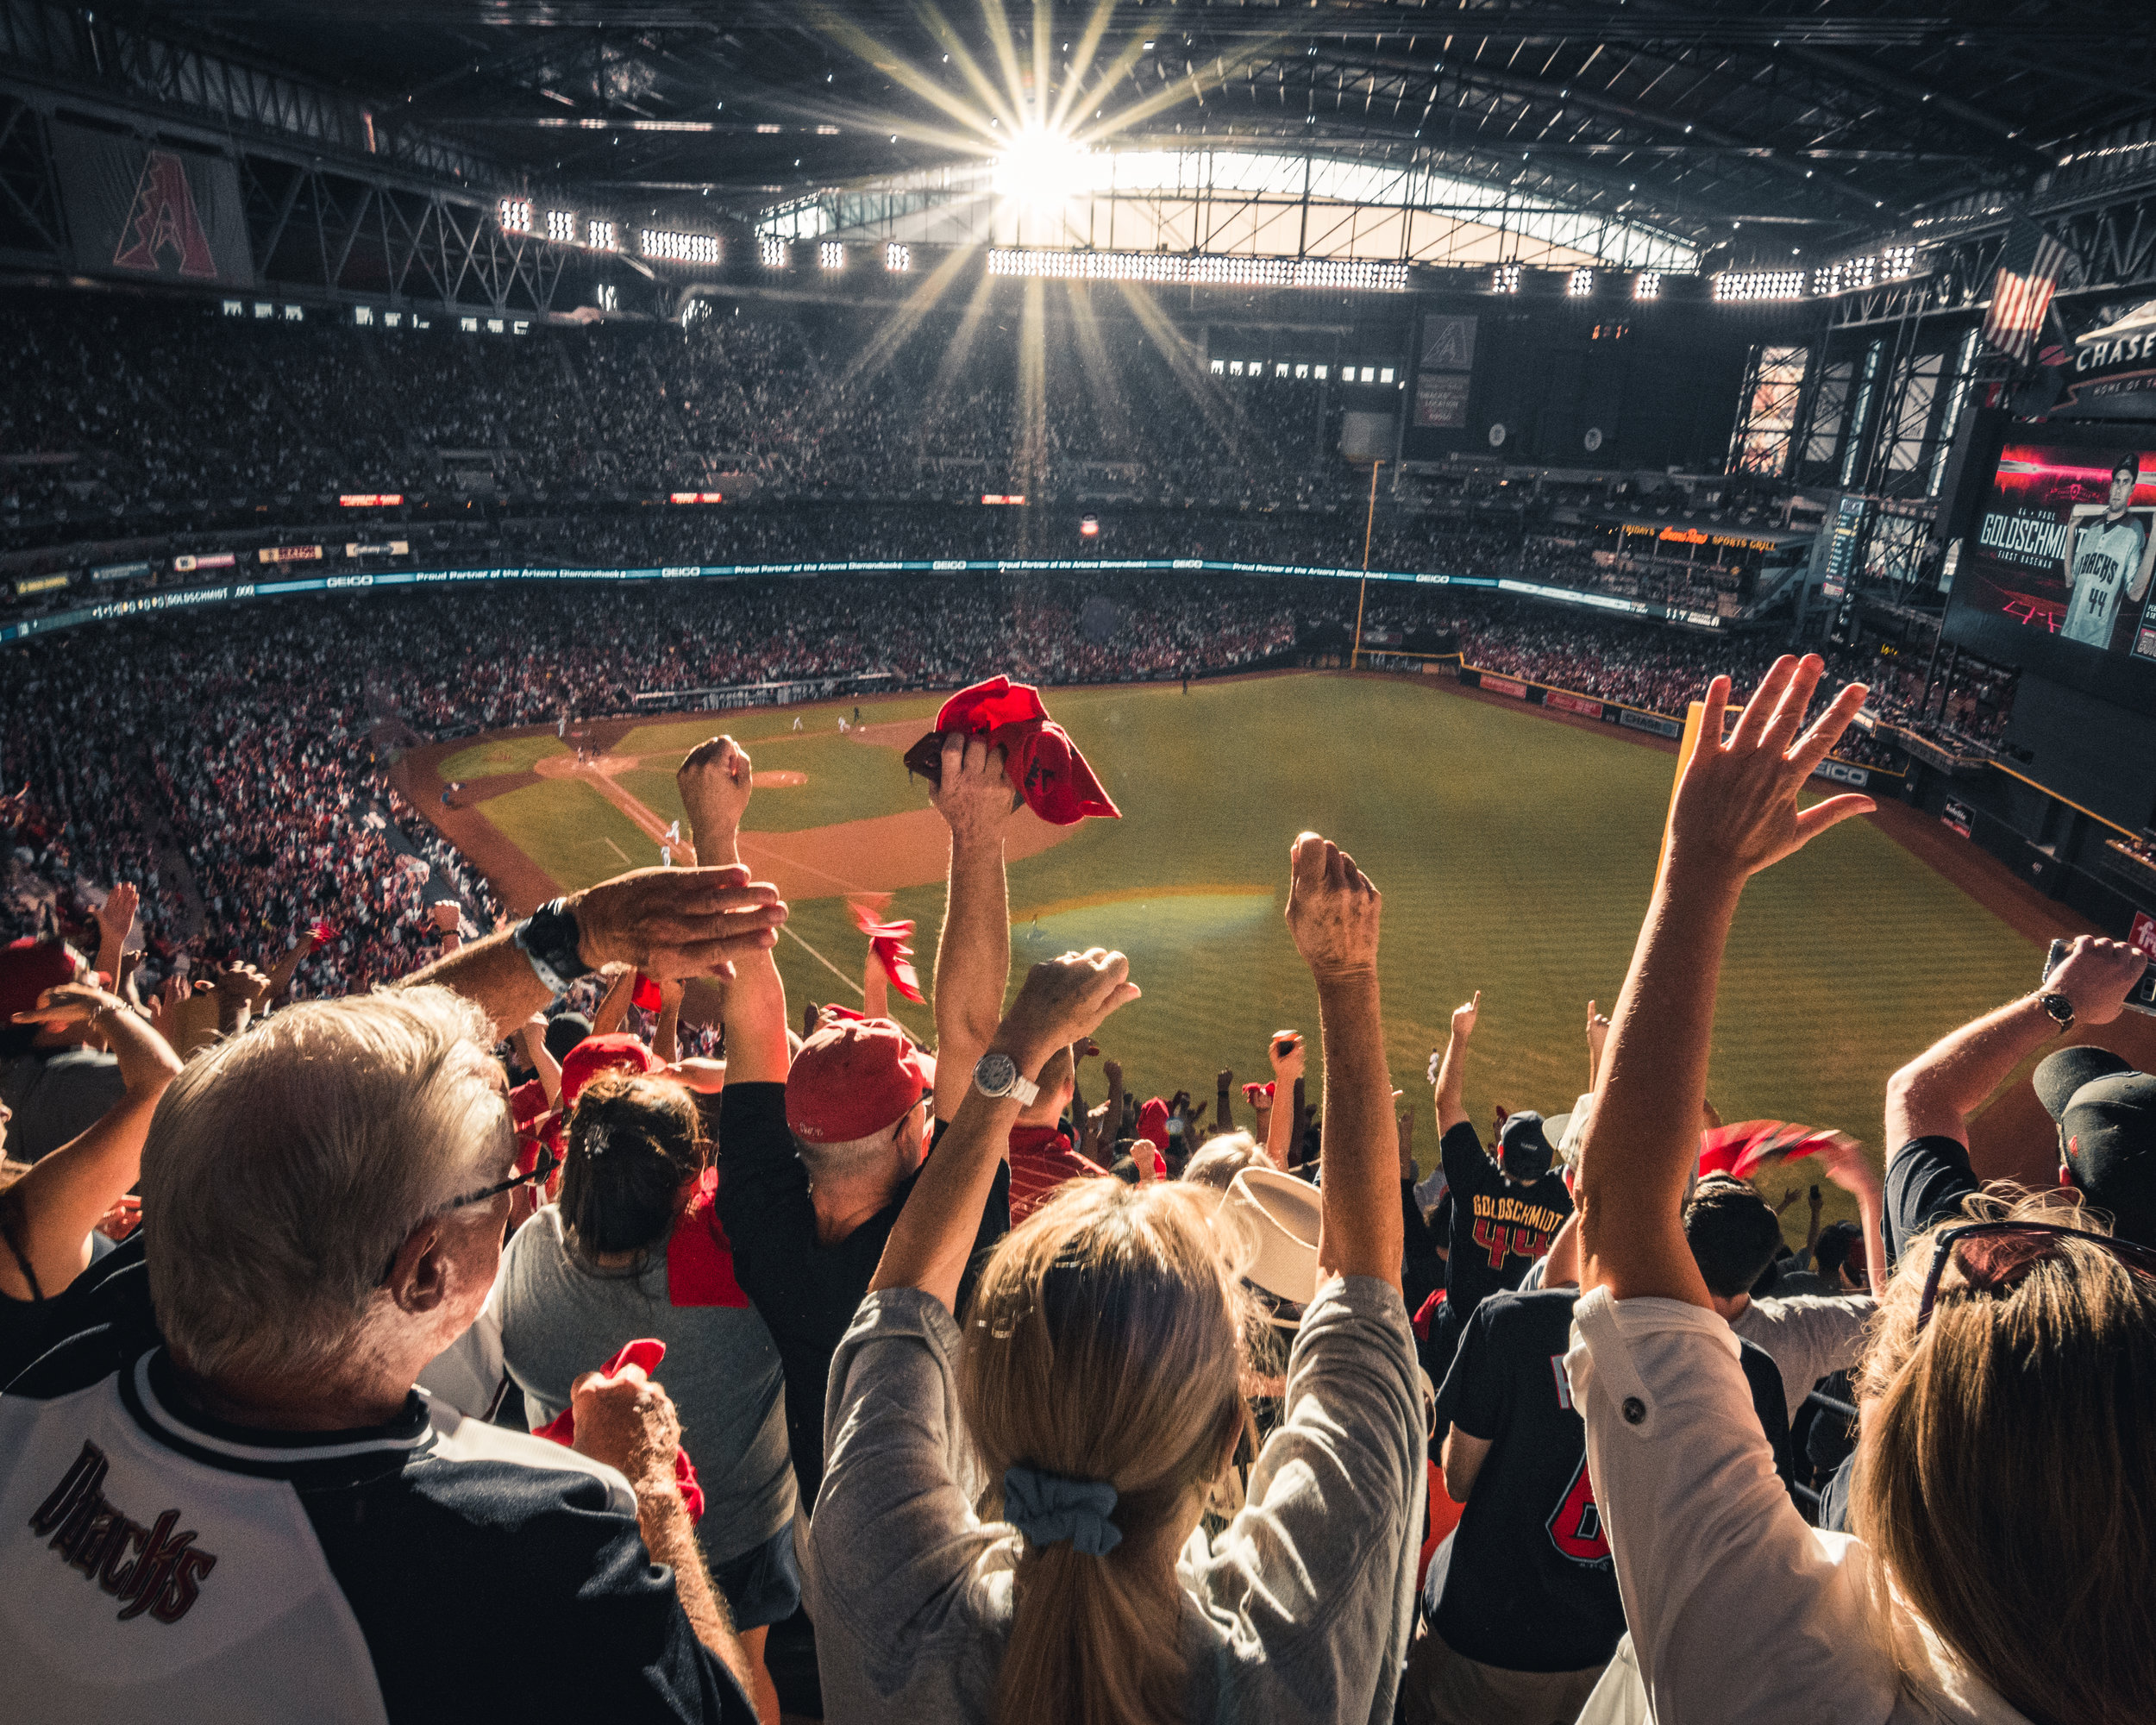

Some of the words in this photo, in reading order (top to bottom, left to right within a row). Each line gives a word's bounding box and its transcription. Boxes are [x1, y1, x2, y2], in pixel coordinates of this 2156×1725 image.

[2076, 332, 2156, 372] CHASE
[1621, 524, 1655, 537] FRIDAYS
[1712, 535, 1747, 549] SPORTS
[1749, 541, 1777, 552] GRILL
[932, 561, 966, 570] GEICO
[998, 561, 1020, 569] Proud
[1021, 561, 1050, 569] Partner
[1059, 561, 1072, 569] the
[1072, 561, 1099, 569] Arizona
[1172, 560, 1203, 568] GEICO
[1997, 550, 2018, 561] FIRST
[2021, 556, 2053, 569] BASEMAN
[416, 571, 447, 581] Proud
[449, 569, 488, 580] Partner
[490, 569, 500, 578] of
[502, 568, 519, 577] the
[522, 569, 557, 578] Arizona
[560, 569, 626, 578] Diamondbacks
[661, 567, 700, 578] GEICO
[734, 565, 760, 574] Proud
[761, 564, 792, 574] Partner
[793, 563, 802, 572] of
[818, 562, 847, 571] Arizona
[1232, 562, 1255, 571] Proud
[1256, 563, 1285, 573] Partner
[1294, 566, 1307, 574] the
[1307, 567, 1336, 576] Arizona
[326, 574, 373, 588] GEICO
[1415, 574, 1450, 584] GEICO
[167, 586, 229, 605] GOLDSCHMIDT
[2089, 587, 2109, 618] 44
[1814, 761, 1865, 785] EICO
[1472, 1194, 1564, 1233] GOLDSCHMIDT
[1472, 1217, 1553, 1272] 44
